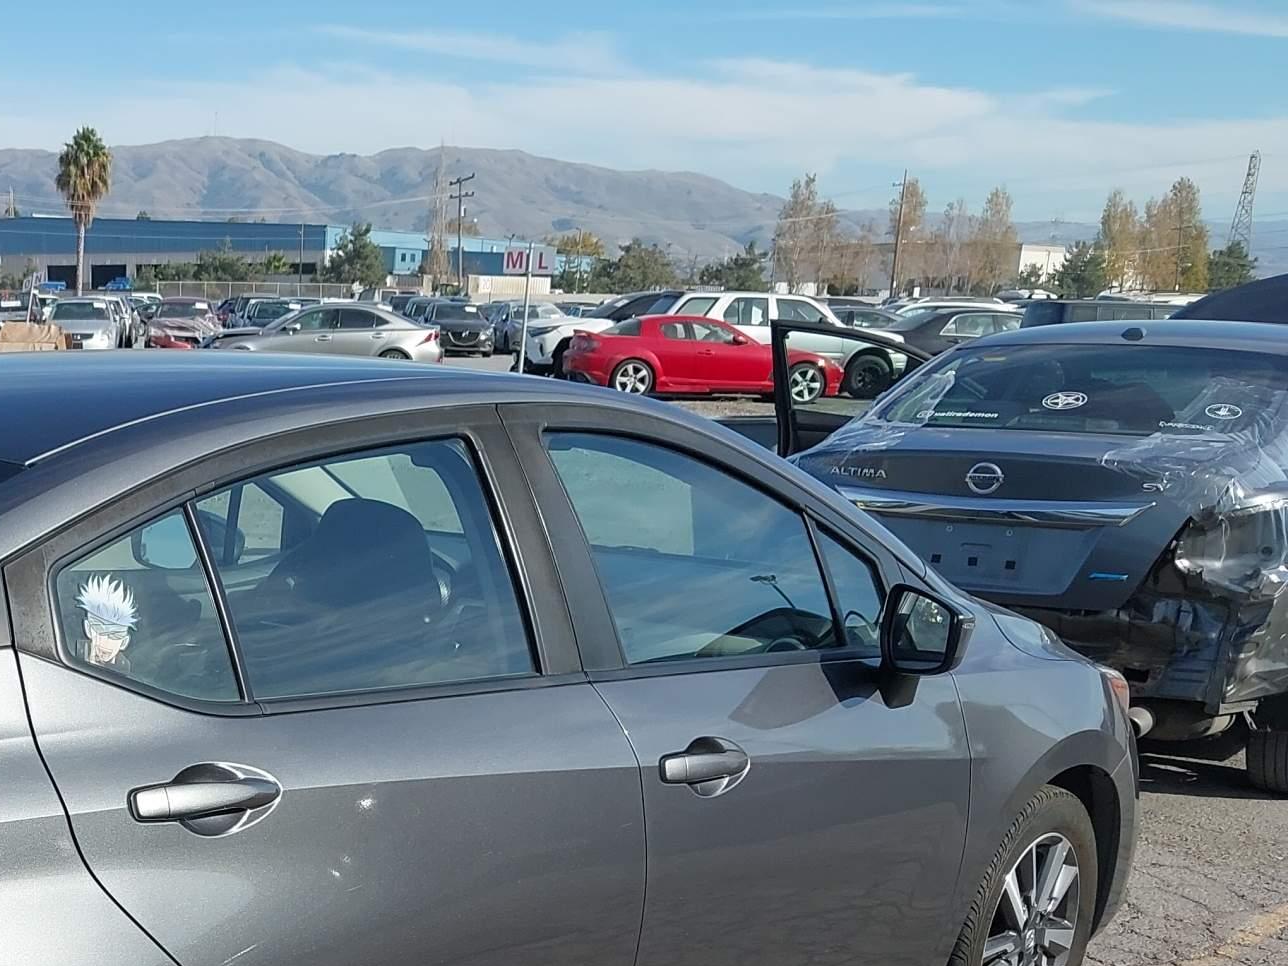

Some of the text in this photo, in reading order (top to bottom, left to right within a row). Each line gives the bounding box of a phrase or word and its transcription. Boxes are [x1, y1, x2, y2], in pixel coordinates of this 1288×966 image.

[506, 251, 549, 270] M L
[830, 465, 888, 479] ALTIMA
